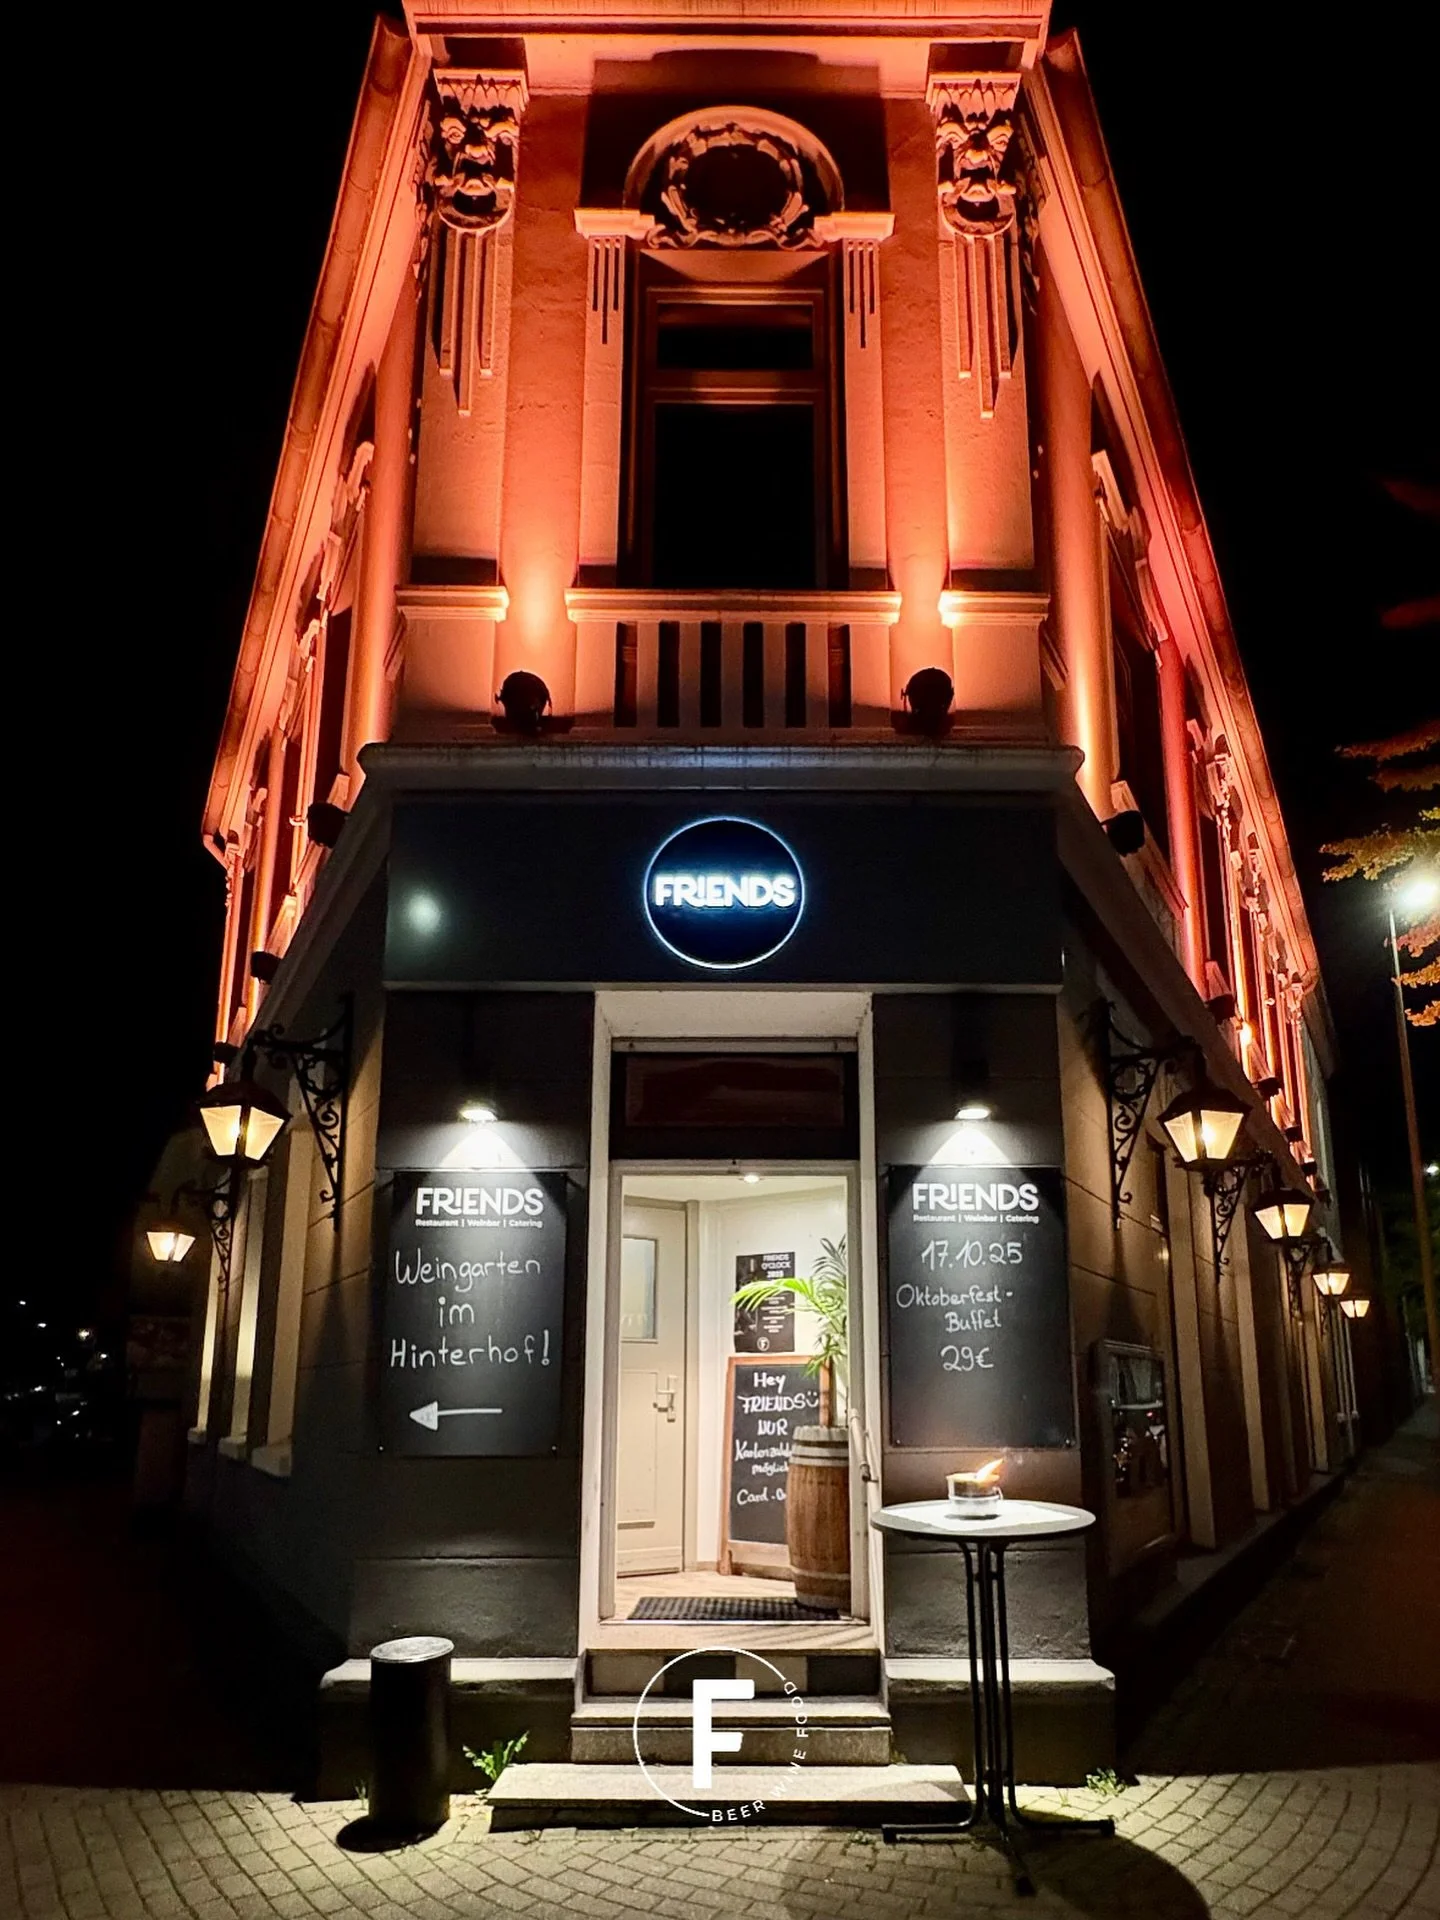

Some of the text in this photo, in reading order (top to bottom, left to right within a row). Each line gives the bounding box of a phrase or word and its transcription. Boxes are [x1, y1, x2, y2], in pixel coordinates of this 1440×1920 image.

[655, 874, 797, 908] FRIENDS
[416, 1187, 544, 1216] FRIENDS
[912, 1183, 1039, 1212] FRIENDS
[415, 1218, 459, 1228] Restaurant
[467, 1218, 500, 1228] Weinbar
[508, 1218, 544, 1229] Catering
[913, 1213, 957, 1223] Restaurant
[964, 1213, 998, 1223] Weinbar
[1005, 1213, 1040, 1225] Catering
[920, 1239, 1023, 1270] 17.10.25
[395, 1247, 541, 1293] Weingarten
[438, 1296, 475, 1328] im
[944, 1308, 1002, 1333] Buffet
[390, 1329, 550, 1369] Hinterhof!
[940, 1345, 994, 1372] 29€
[753, 1372, 786, 1394] Hey
[757, 1418, 788, 1436] NUR
